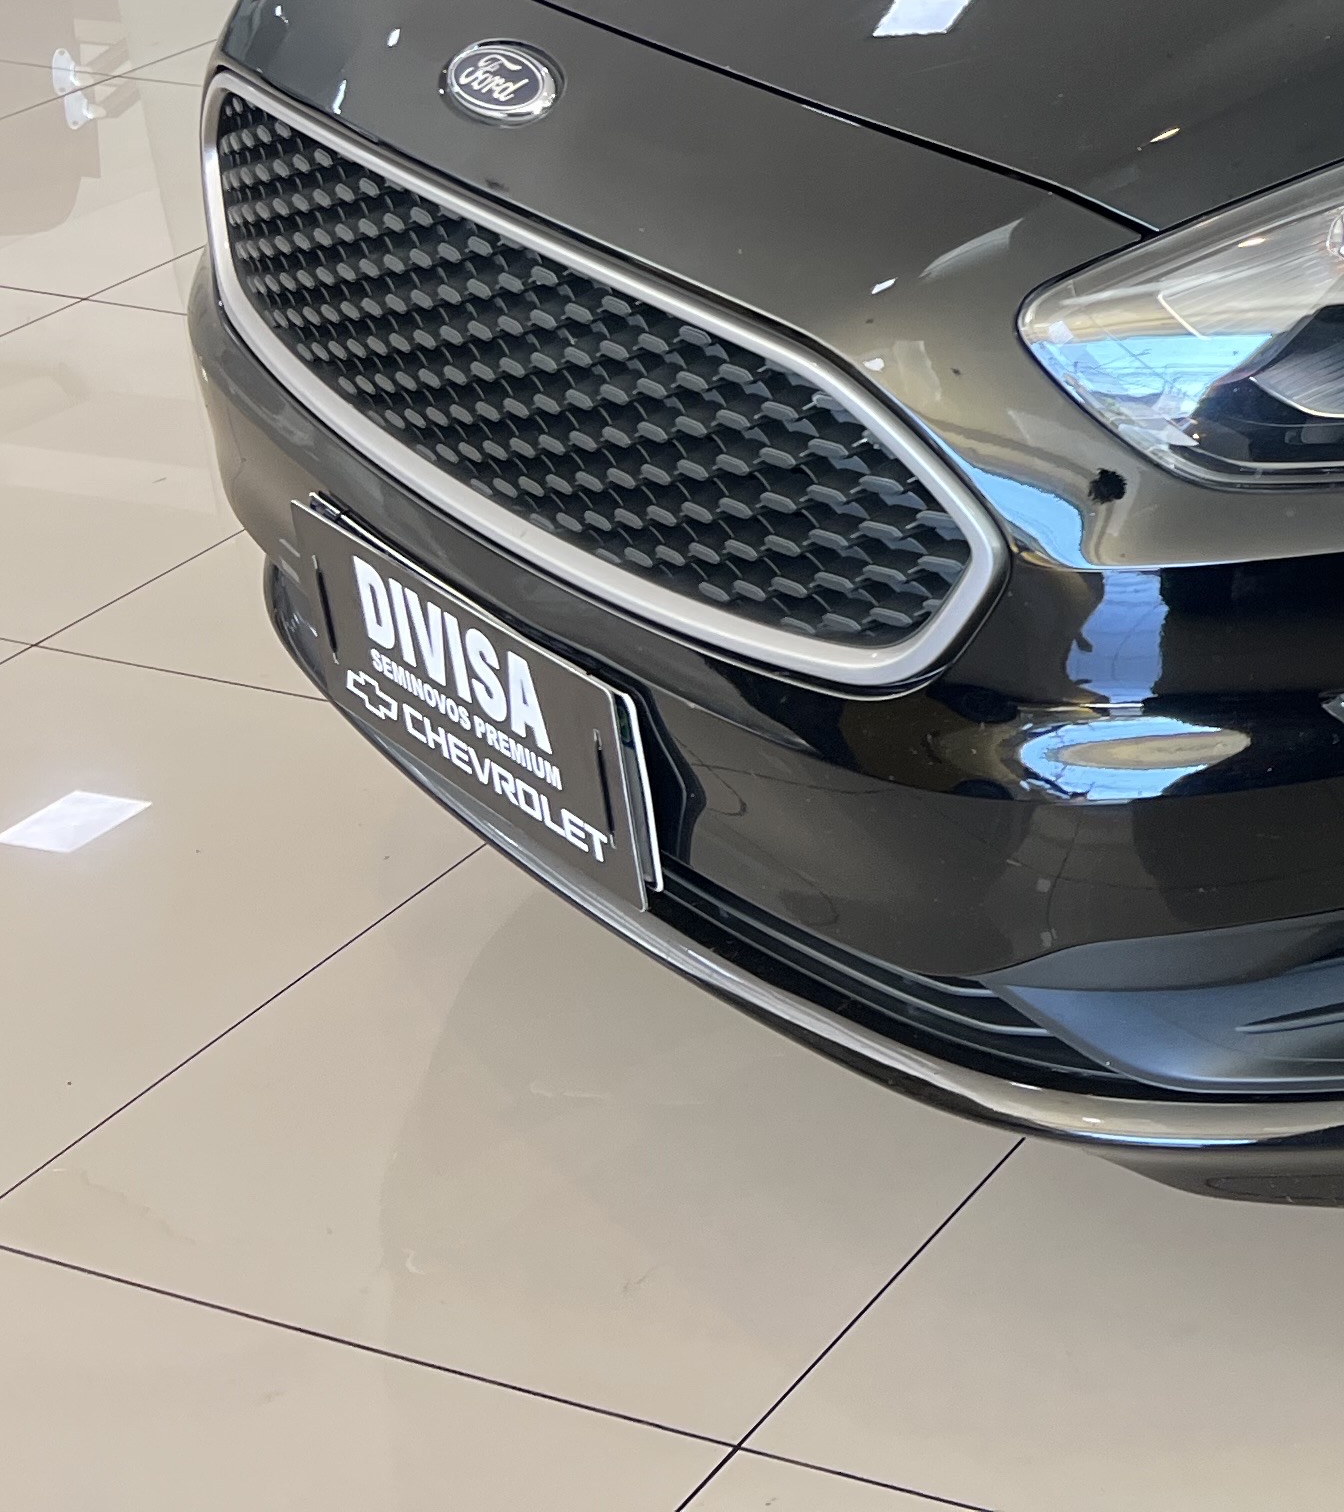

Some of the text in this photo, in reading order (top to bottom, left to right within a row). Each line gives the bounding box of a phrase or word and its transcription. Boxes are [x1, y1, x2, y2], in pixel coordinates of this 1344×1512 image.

[459, 53, 530, 102] Ford
[352, 555, 553, 755] DIVISA
[370, 648, 563, 791] SEMINOVOS PREMIUM
[402, 702, 608, 863] CHEVROLET
